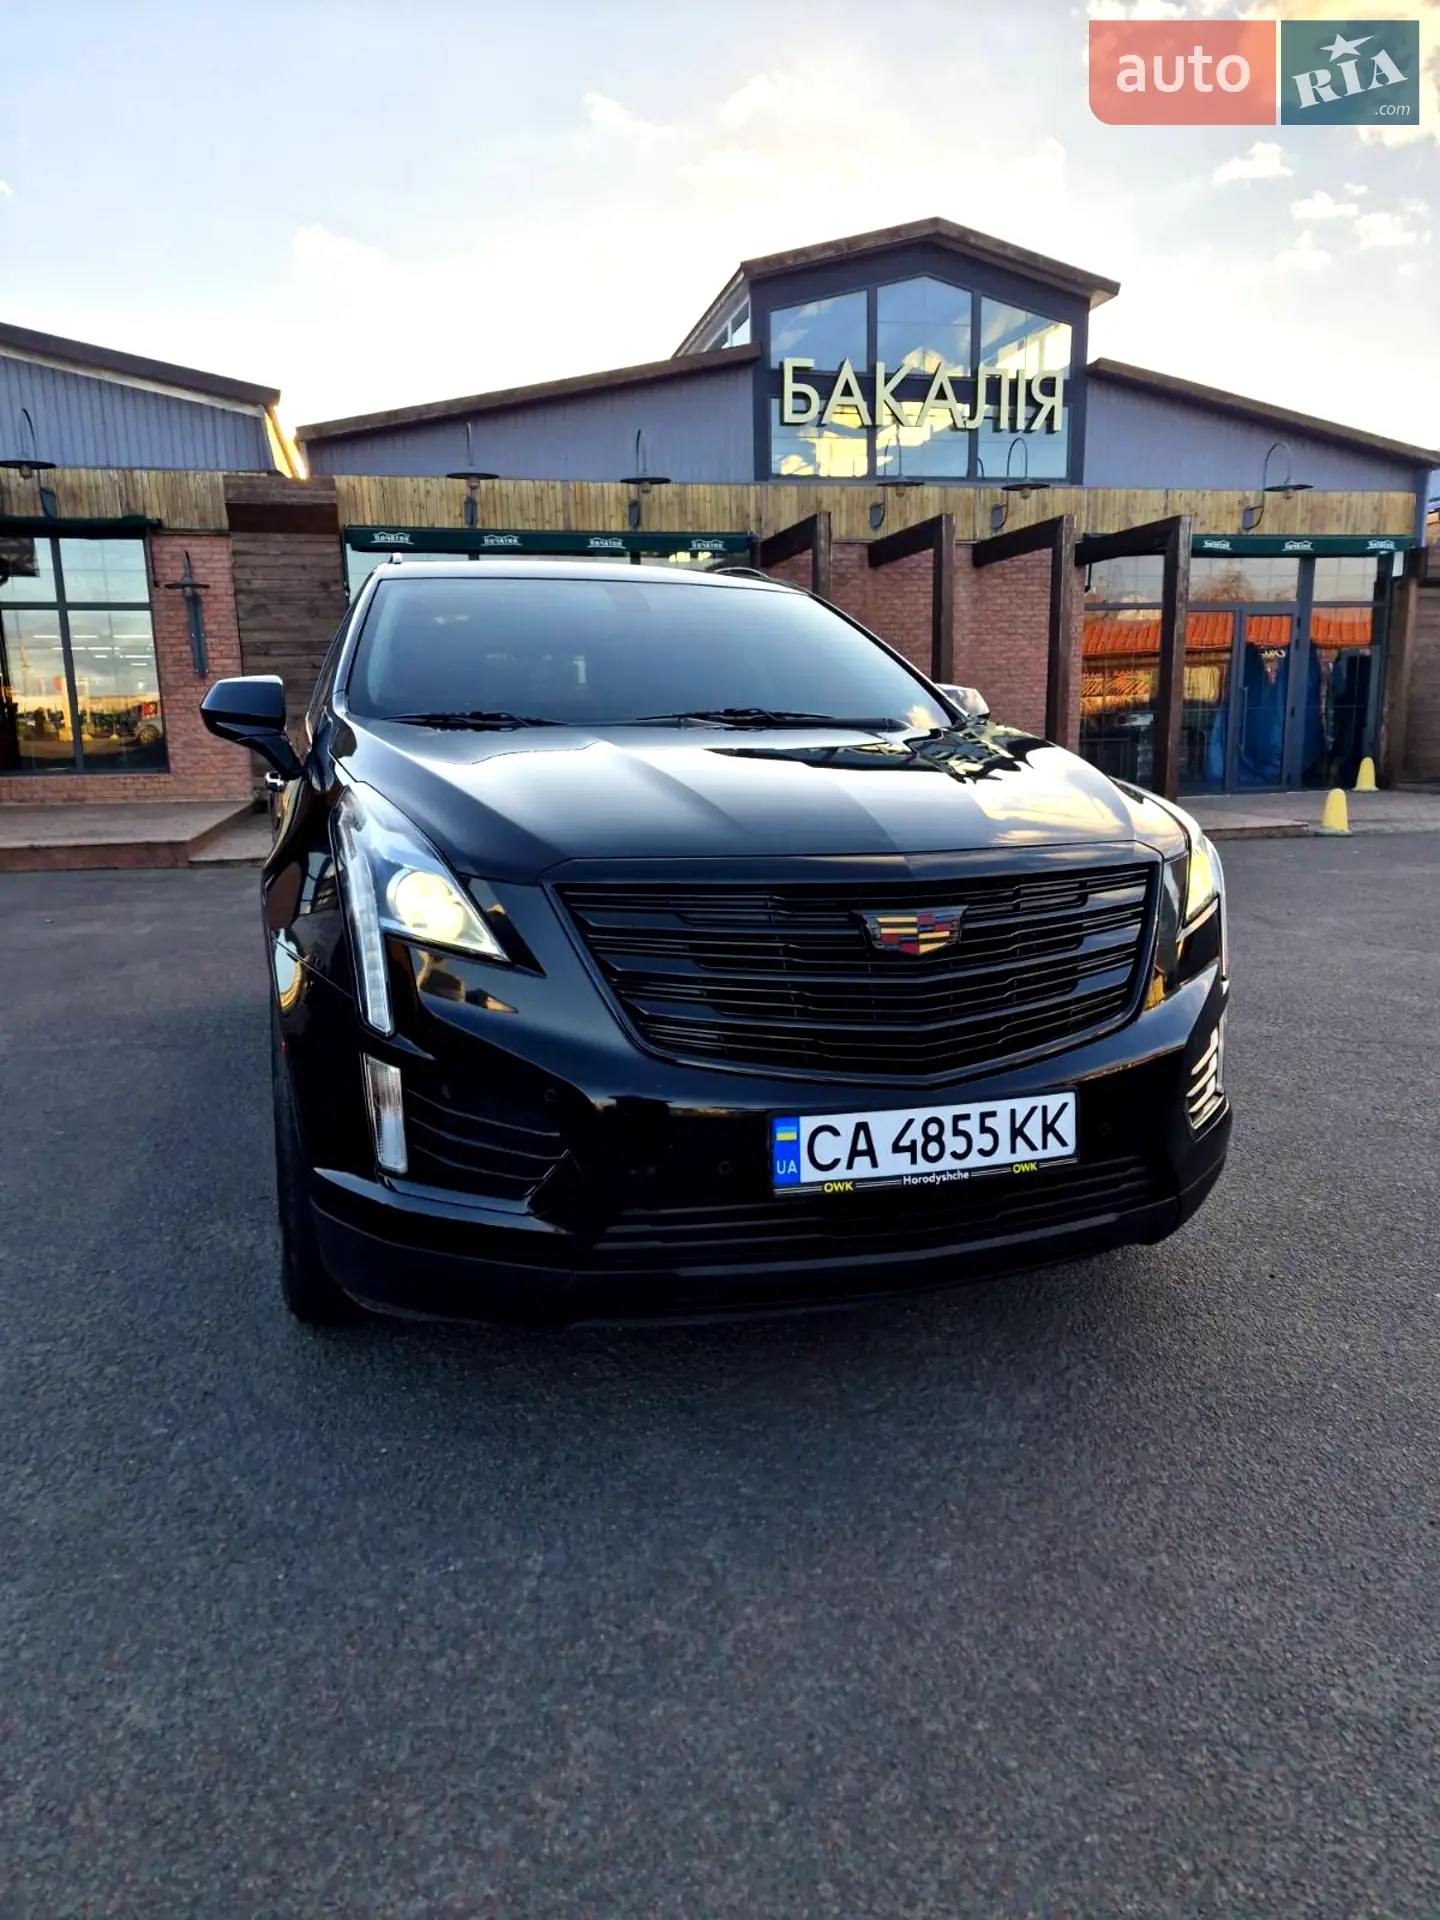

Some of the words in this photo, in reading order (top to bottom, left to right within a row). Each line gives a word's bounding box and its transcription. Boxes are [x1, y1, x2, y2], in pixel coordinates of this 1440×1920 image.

[783, 356, 1063, 431] БАКАЛІЯ
[807, 1121, 878, 1172] CA
[776, 1159, 798, 1175] UA
[824, 1181, 854, 1192] OWK
[903, 1171, 969, 1185] Horodyshche
[1012, 1162, 1038, 1173] OWK
